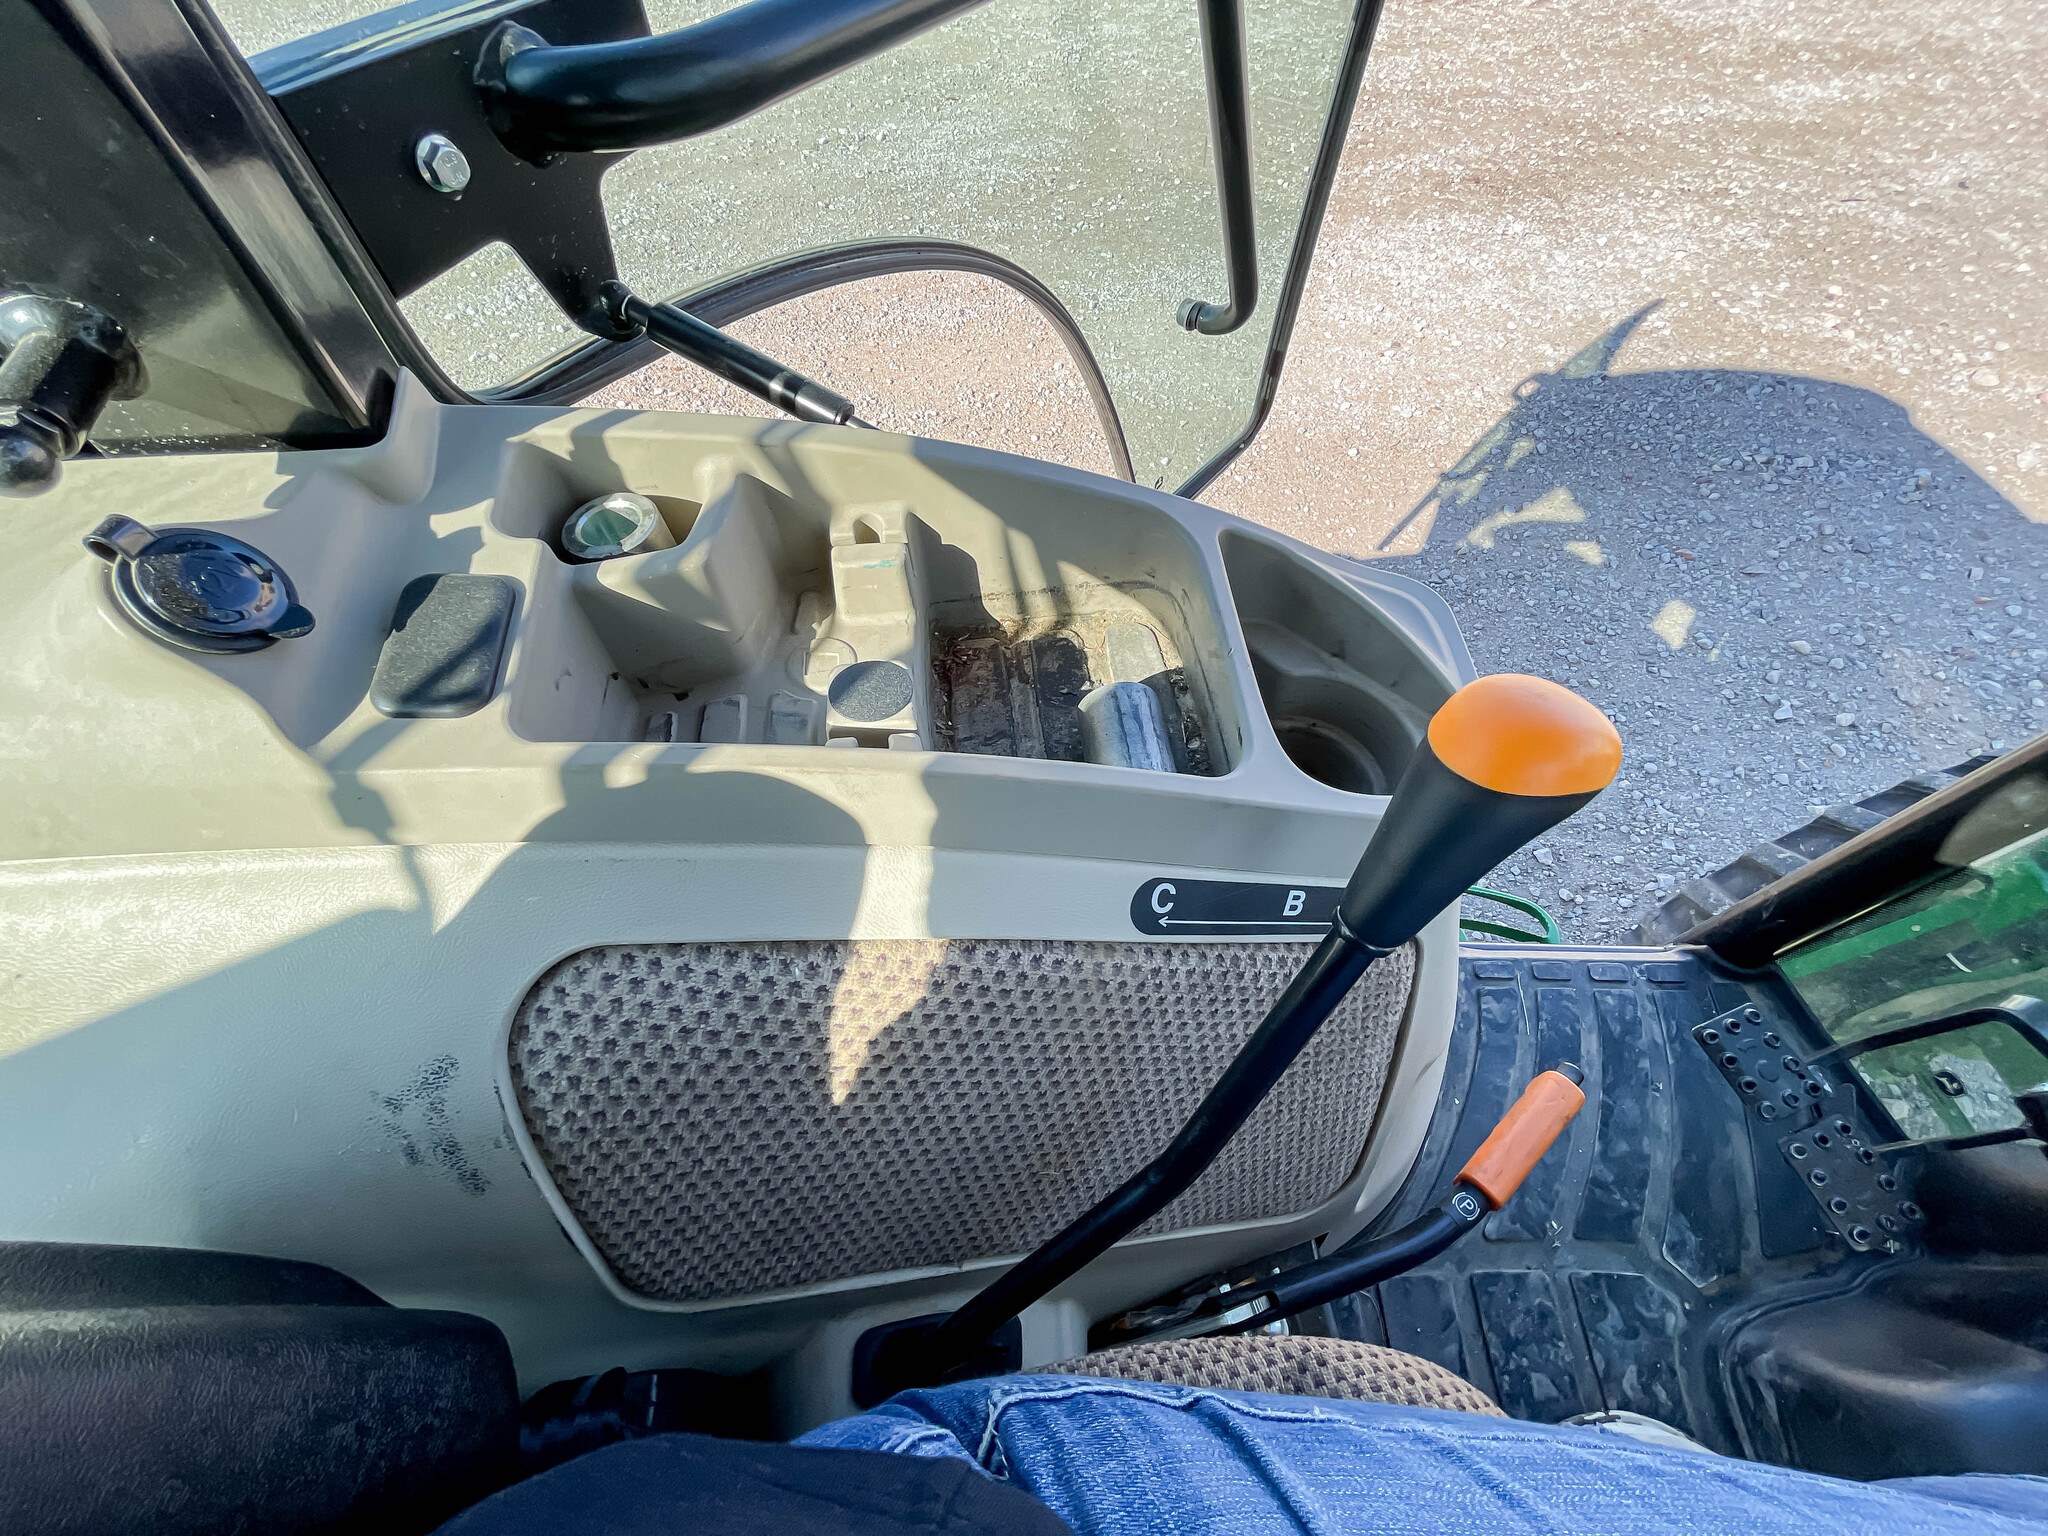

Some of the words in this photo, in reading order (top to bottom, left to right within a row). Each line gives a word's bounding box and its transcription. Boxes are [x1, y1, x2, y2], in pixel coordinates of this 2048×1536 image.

[1151, 883, 1176, 914] C
[1282, 890, 1306, 916] B
[1459, 1198, 1474, 1210] P
